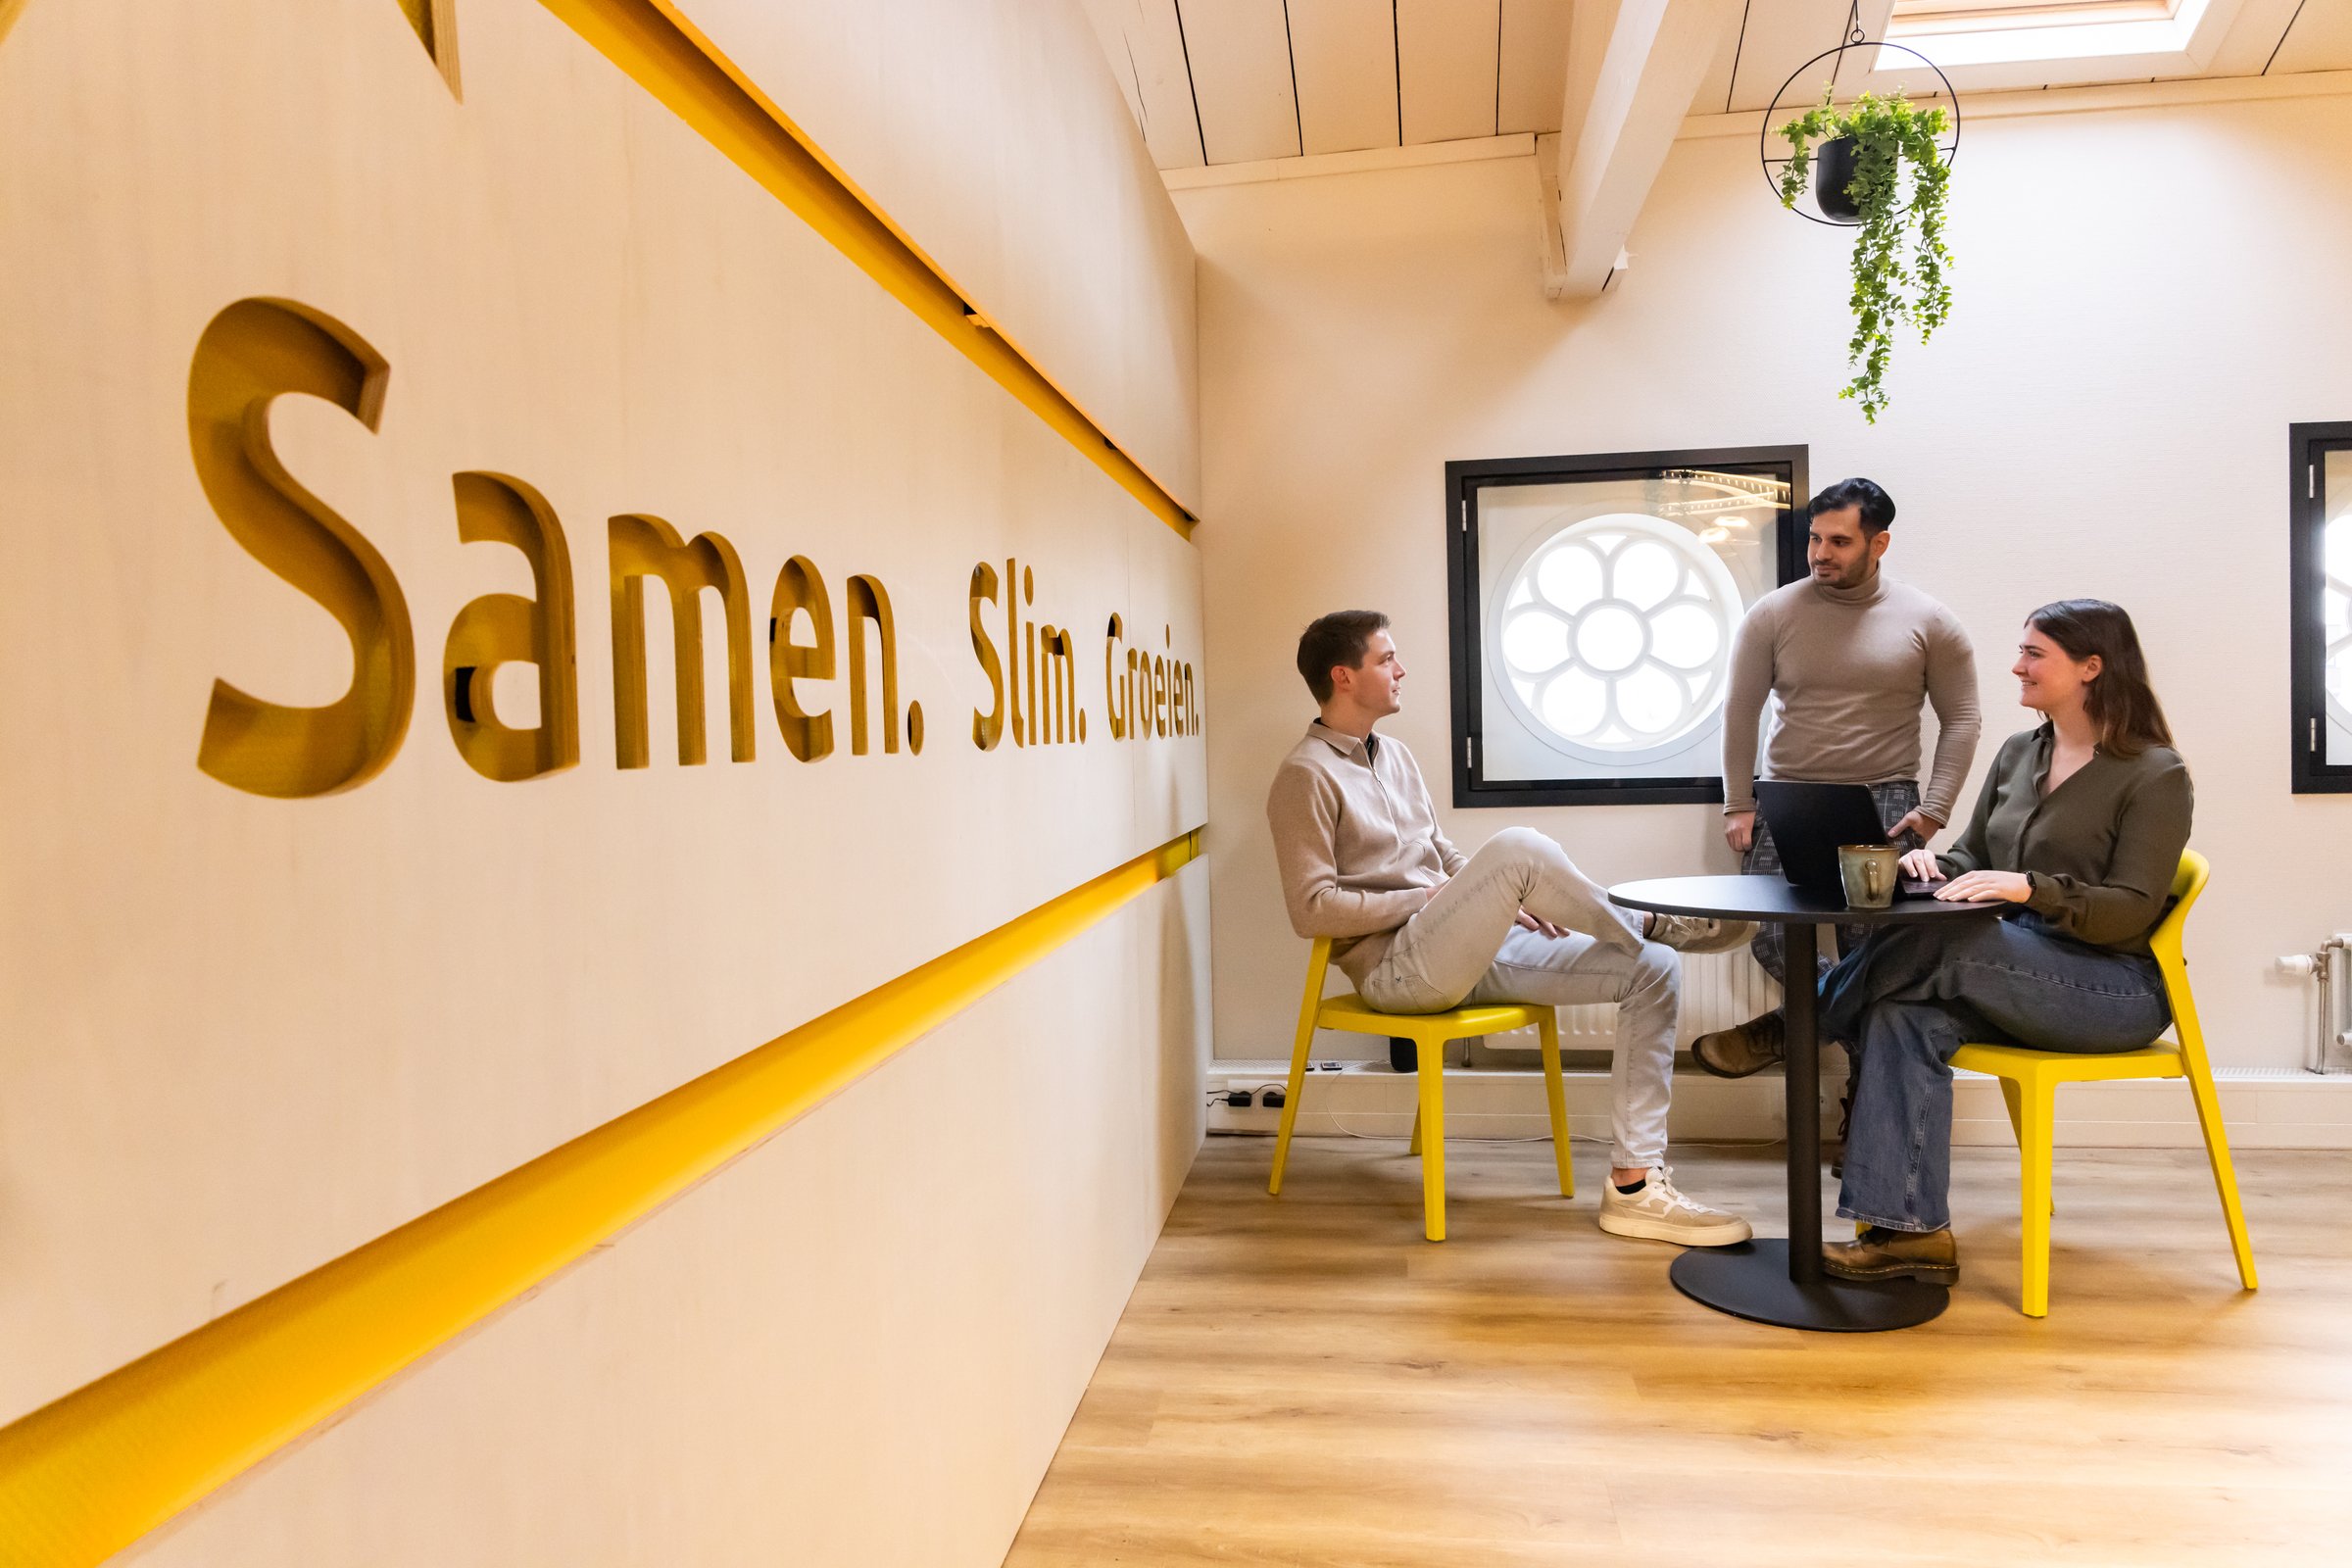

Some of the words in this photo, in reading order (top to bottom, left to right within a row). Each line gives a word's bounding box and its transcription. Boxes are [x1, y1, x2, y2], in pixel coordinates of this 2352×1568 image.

[187, 295, 924, 799] Samen.
[969, 557, 1086, 752] Slim.
[1106, 612, 1199, 742] Groeien.
